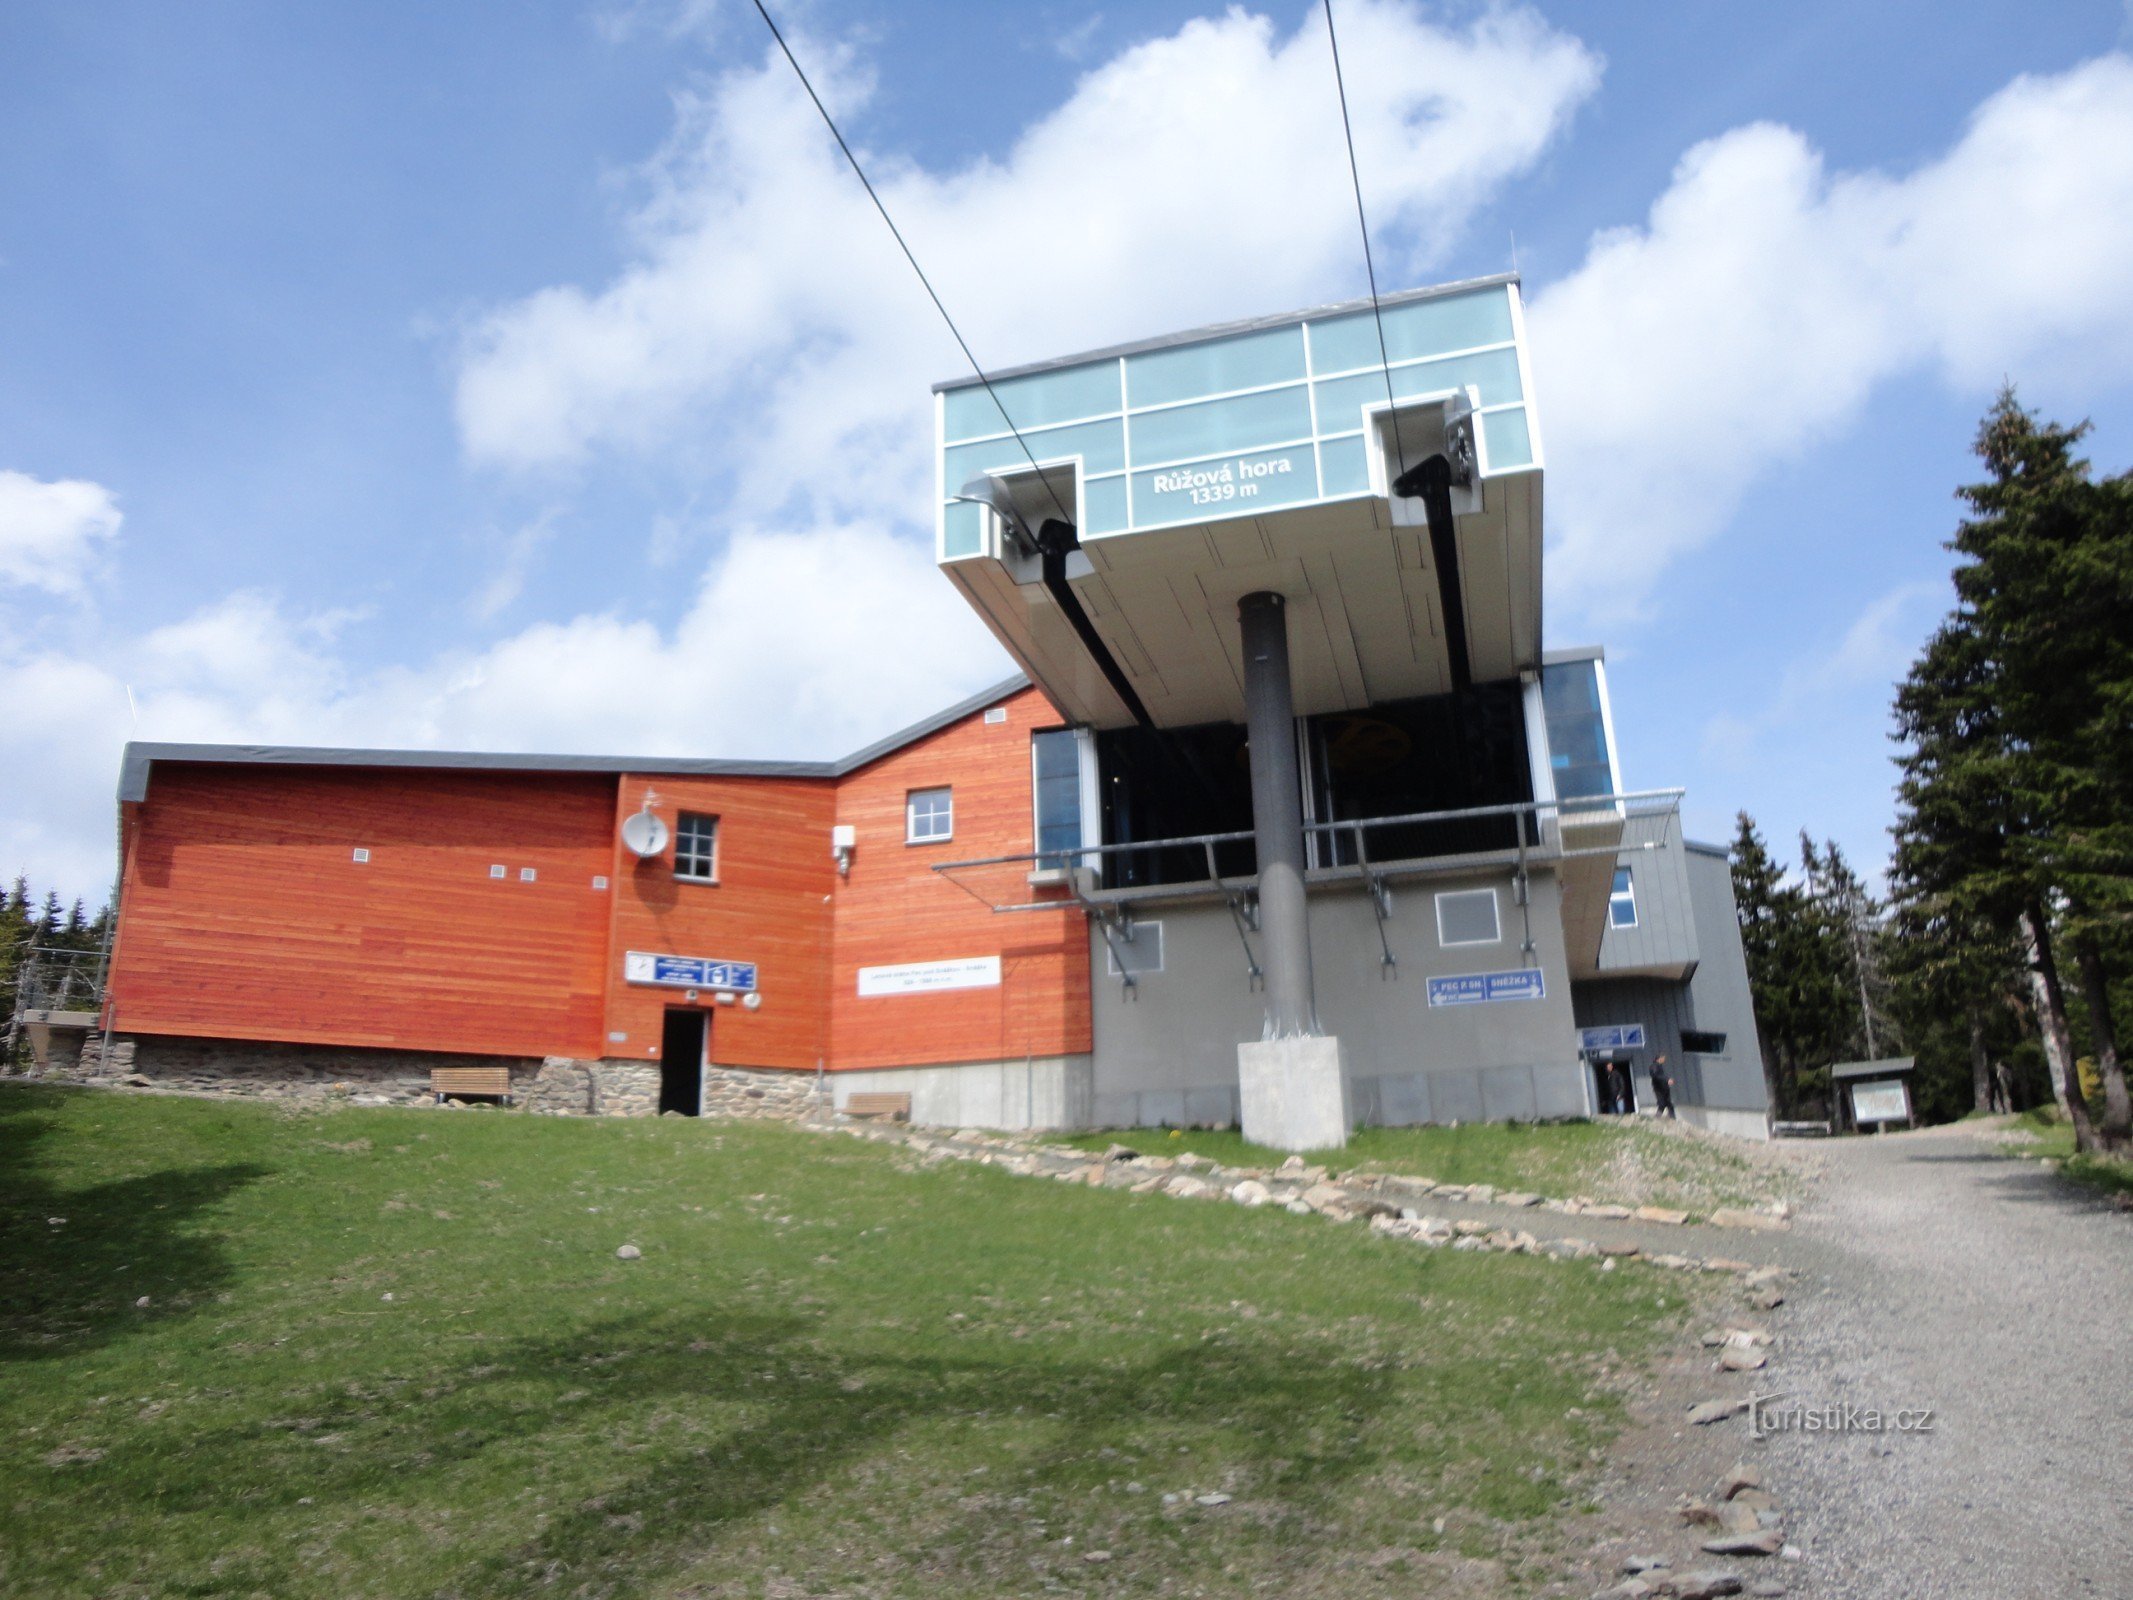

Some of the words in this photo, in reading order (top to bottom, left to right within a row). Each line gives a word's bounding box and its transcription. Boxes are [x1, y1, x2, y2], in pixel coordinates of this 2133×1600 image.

[1154, 463, 1233, 493] Růžová
[1238, 457, 1292, 480] hora
[1189, 483, 1235, 504] 1339
[1239, 483, 1258, 497] m
[1441, 981, 1459, 991] PEC
